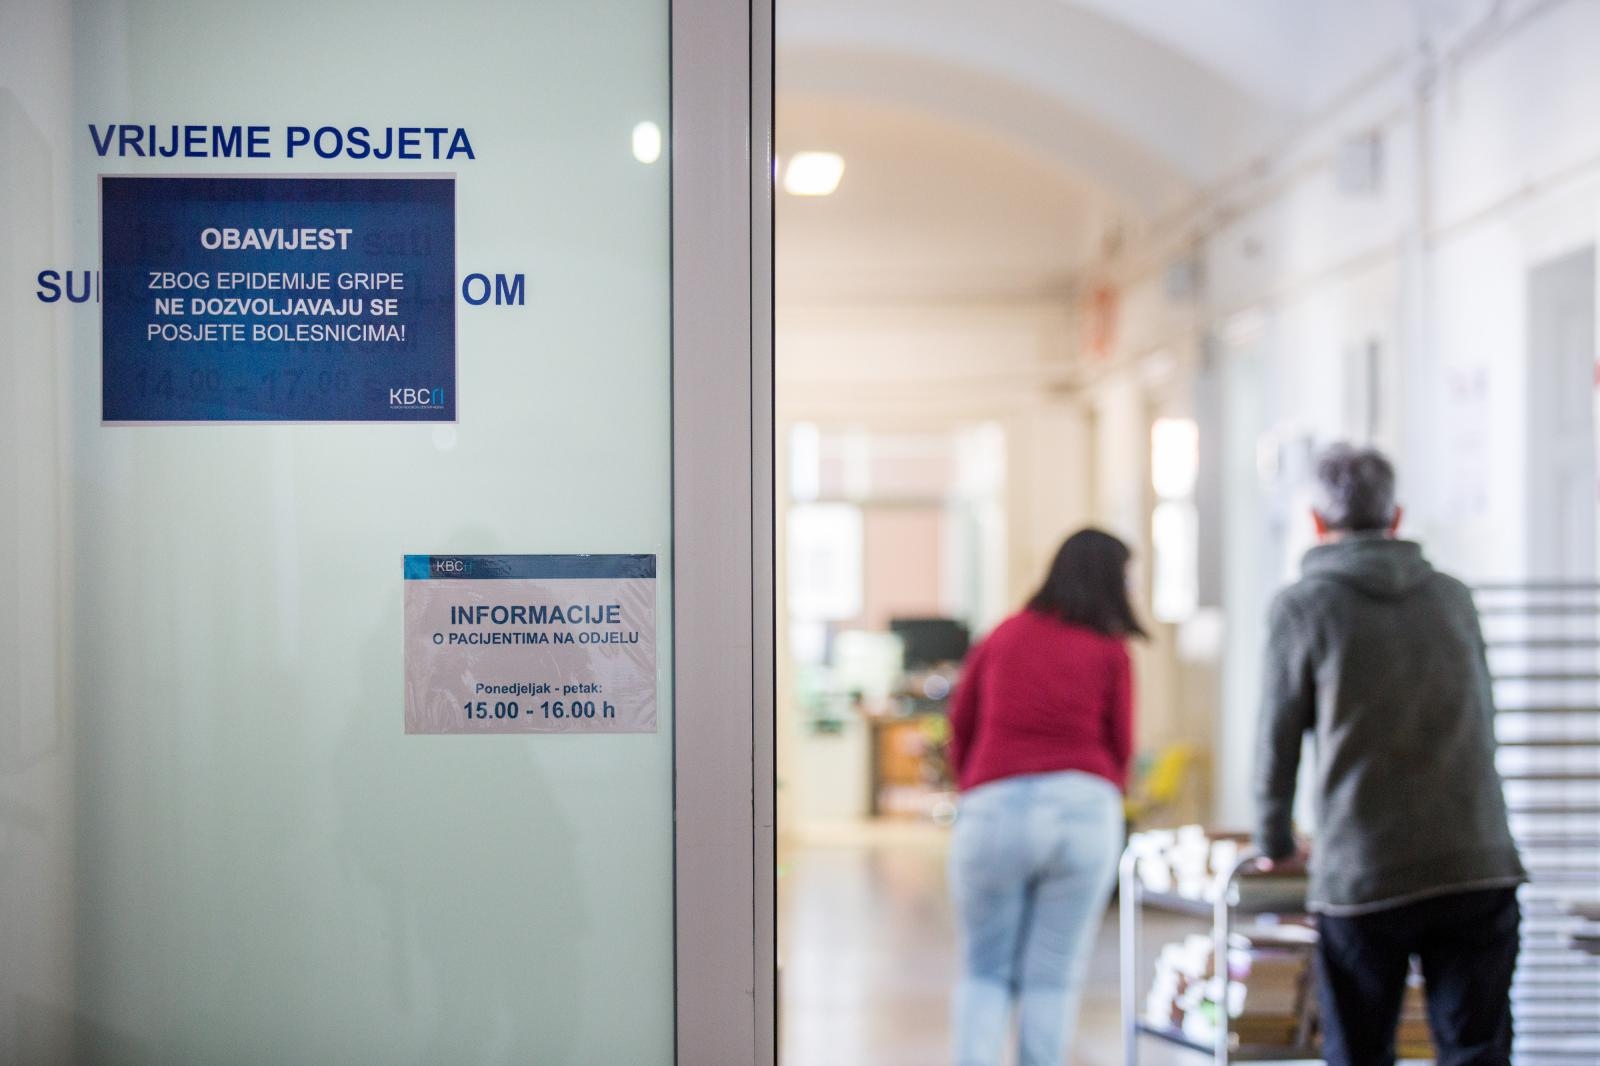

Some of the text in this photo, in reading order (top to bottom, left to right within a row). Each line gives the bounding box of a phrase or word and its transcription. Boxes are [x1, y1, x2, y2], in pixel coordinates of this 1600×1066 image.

[88, 124, 475, 159] VRIJEME POSJETA
[201, 228, 352, 250] OBAVIJEST
[36, 270, 99, 302] SU
[149, 272, 403, 289] ZBOG EPIDEMIJE GRIPE
[462, 273, 524, 305] OM
[156, 298, 398, 315] NE DOZVOLJAVAJU SE
[148, 324, 245, 341] POSJETE
[253, 324, 404, 341] BOLESNICIMA!
[451, 605, 620, 624] INFORMACIJE
[433, 632, 638, 644] O PACIJENTIMA NA ODJELU
[476, 683, 551, 696] Ponedjeljak
[563, 683, 602, 696] petak:
[464, 702, 518, 719] 15.00
[541, 701, 595, 718] 16.00
[603, 701, 614, 718] h
